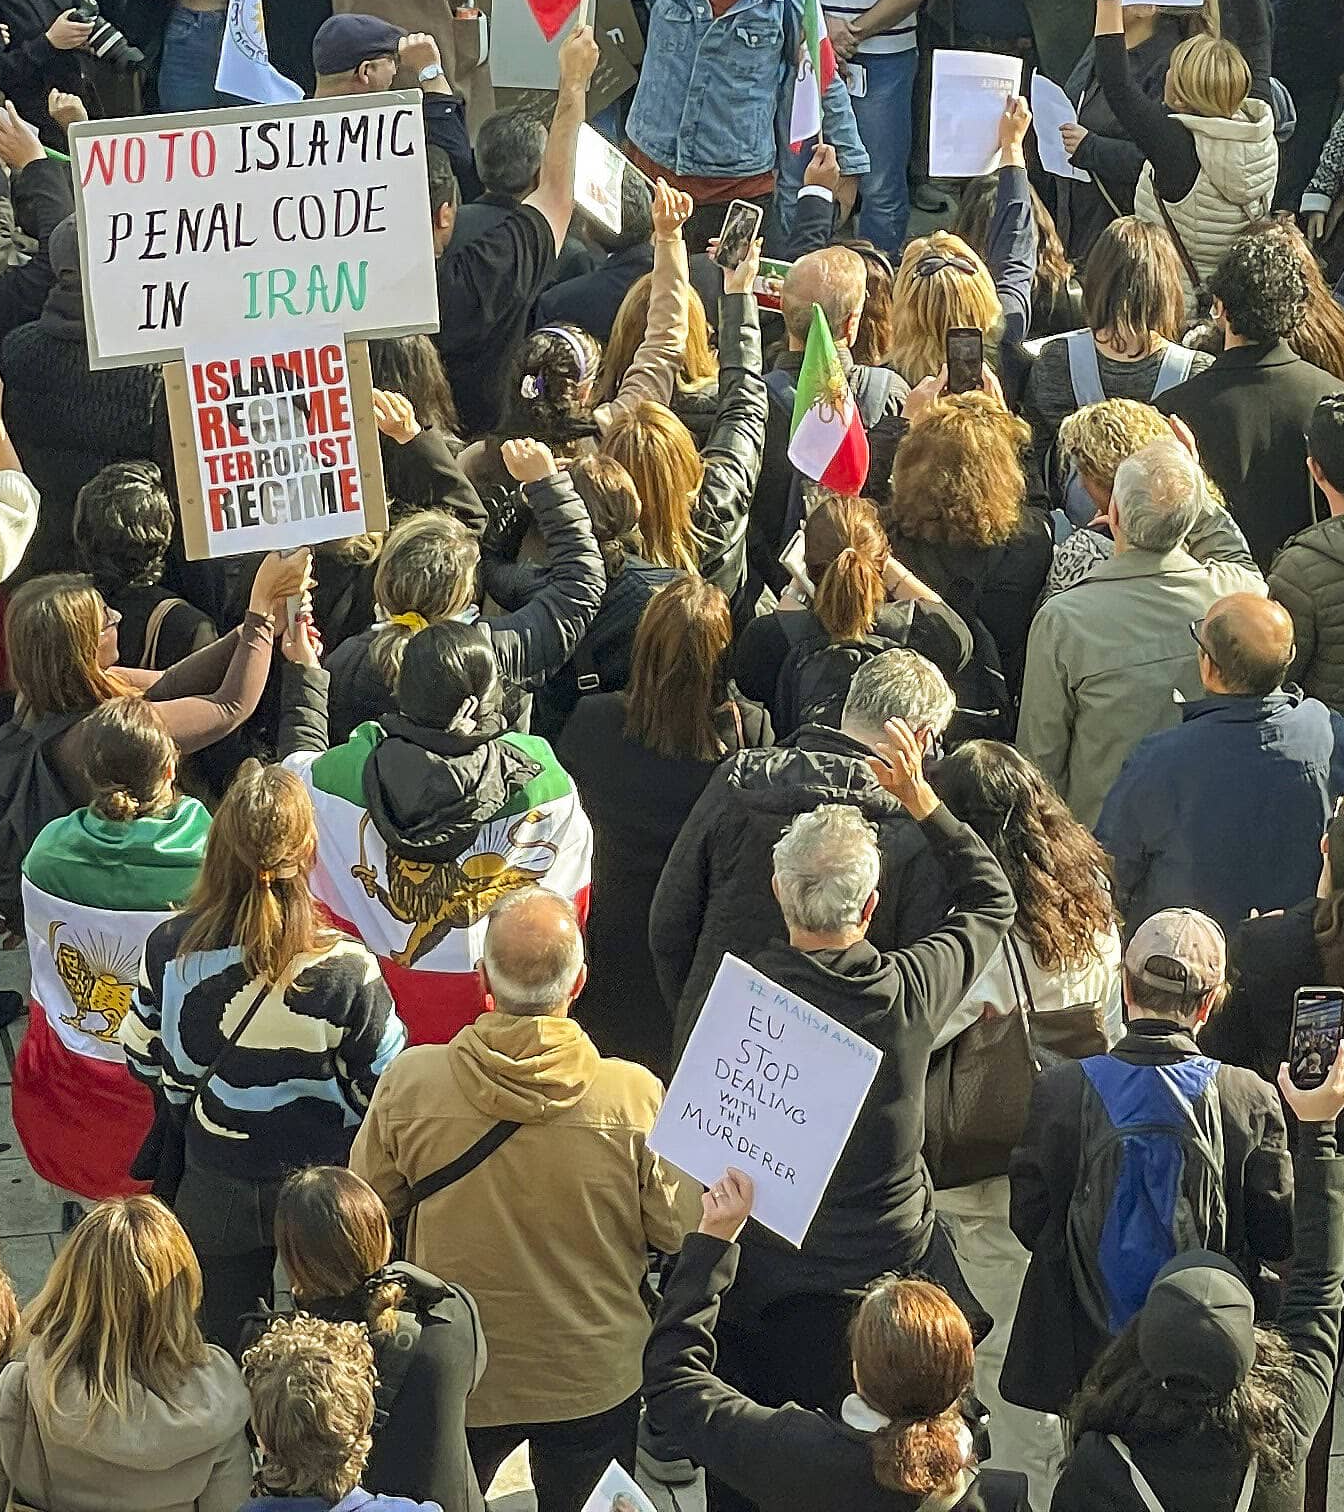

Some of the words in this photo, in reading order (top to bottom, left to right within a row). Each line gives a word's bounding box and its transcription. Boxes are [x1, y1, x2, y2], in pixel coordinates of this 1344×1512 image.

[81, 137, 147, 188] NO
[158, 130, 217, 183] TO
[234, 110, 414, 174] ISLAMIC
[103, 202, 257, 264] PENAL
[273, 184, 388, 242] CODE
[137, 281, 190, 331] IN
[242, 260, 369, 320] IRAN
[192, 344, 345, 404] ISLAMIC
[197, 387, 351, 451] REGIME
[204, 434, 352, 485] TERRORIST
[208, 468, 361, 533] REGIME
[714, 1058, 807, 1126] DEALING
[736, 1039, 799, 1089] STOP
[719, 1089, 757, 1121] WITH
[719, 1105, 742, 1127] THE
[681, 1103, 796, 1185] MURDERER
